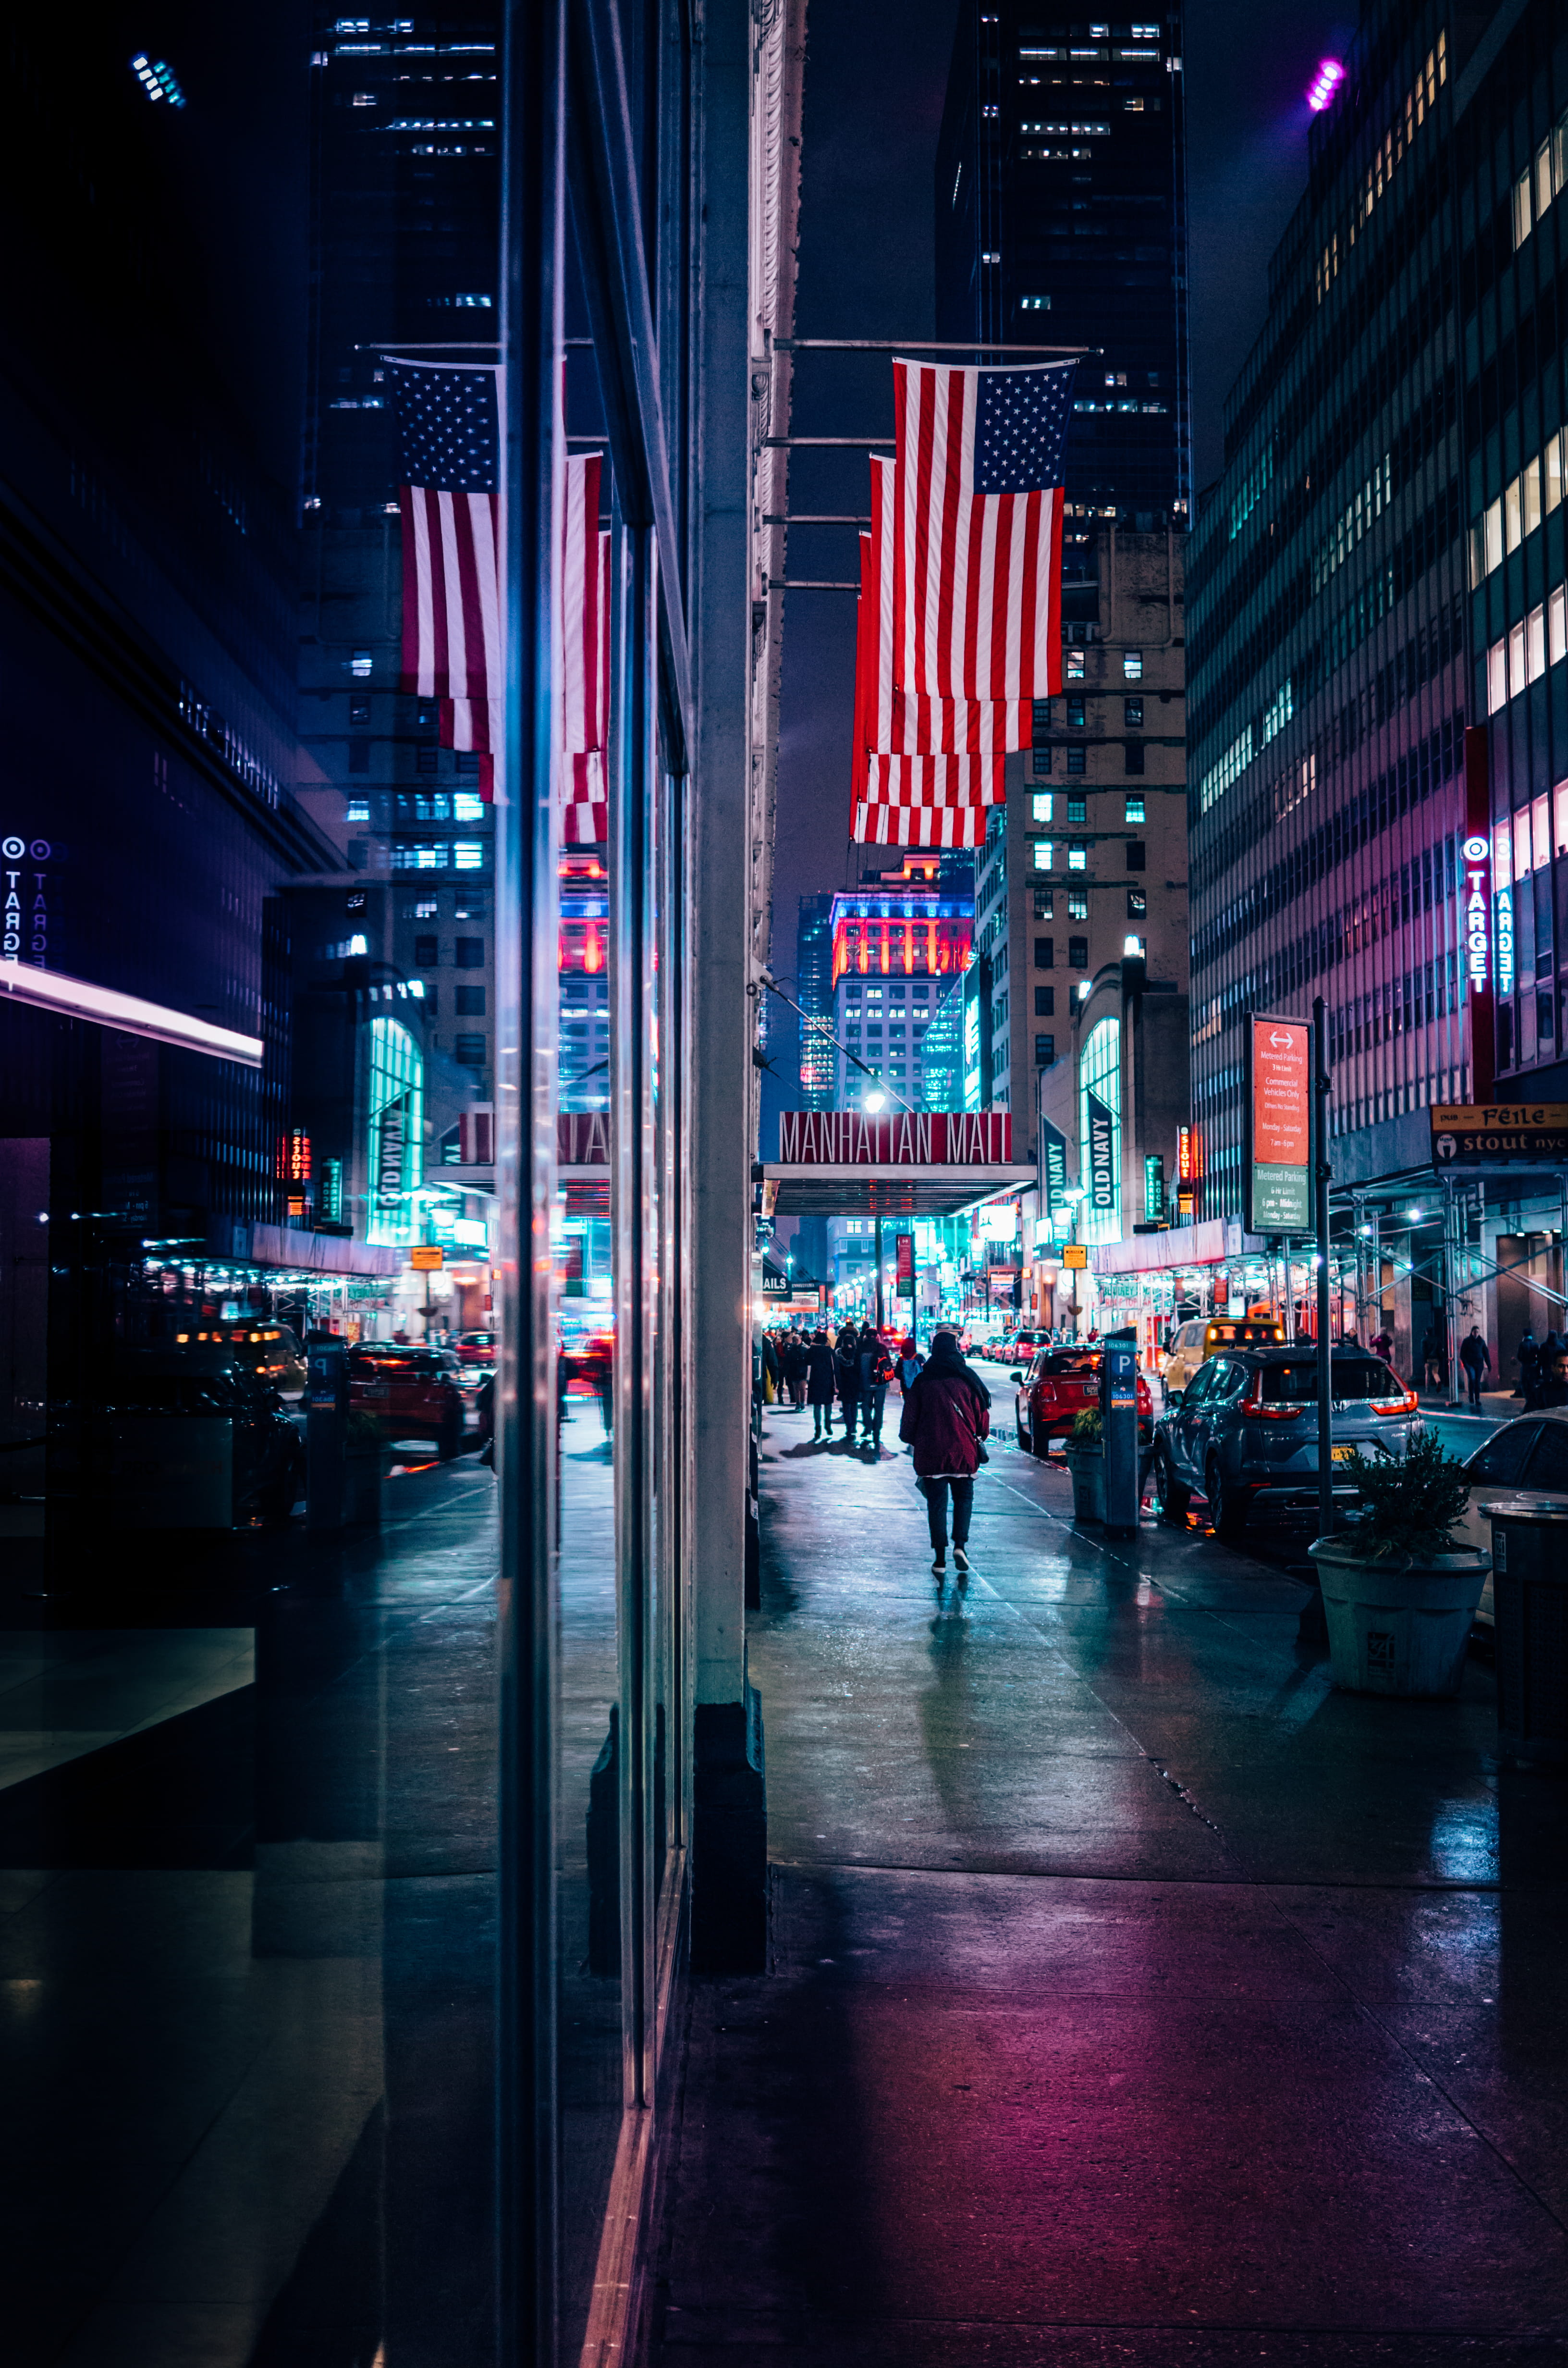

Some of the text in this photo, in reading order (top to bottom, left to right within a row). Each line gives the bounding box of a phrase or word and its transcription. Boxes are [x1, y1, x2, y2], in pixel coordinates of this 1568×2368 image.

[1468, 871, 1487, 992] TARGET
[1261, 1051, 1302, 1064] Metered Parking
[1265, 1077, 1298, 1087] Commercial
[1264, 1088, 1299, 1099] Vehicles Only
[1283, 1104, 1299, 1112] Standing
[1262, 1122, 1280, 1133] Monday
[1283, 1124, 1302, 1134] Saturday
[780, 1111, 1013, 1163] MANHATTAN MALL
[1463, 1135, 1565, 1152] stout nyc
[1093, 1118, 1111, 1205] OLD NAVY
[1049, 1143, 1064, 1207] LD NAVY
[1257, 1170, 1306, 1185] Metered Parking
[1262, 1198, 1265, 1207] 6
[1266, 1200, 1275, 1209] pm
[1280, 1199, 1302, 1210] Midnight
[1263, 1211, 1280, 1221] Monday
[1283, 1211, 1301, 1221] Saturday
[761, 1278, 786, 1289] AILS
[1104, 1286, 1134, 1295] BLNEY
[1119, 1355, 1130, 1373] P
